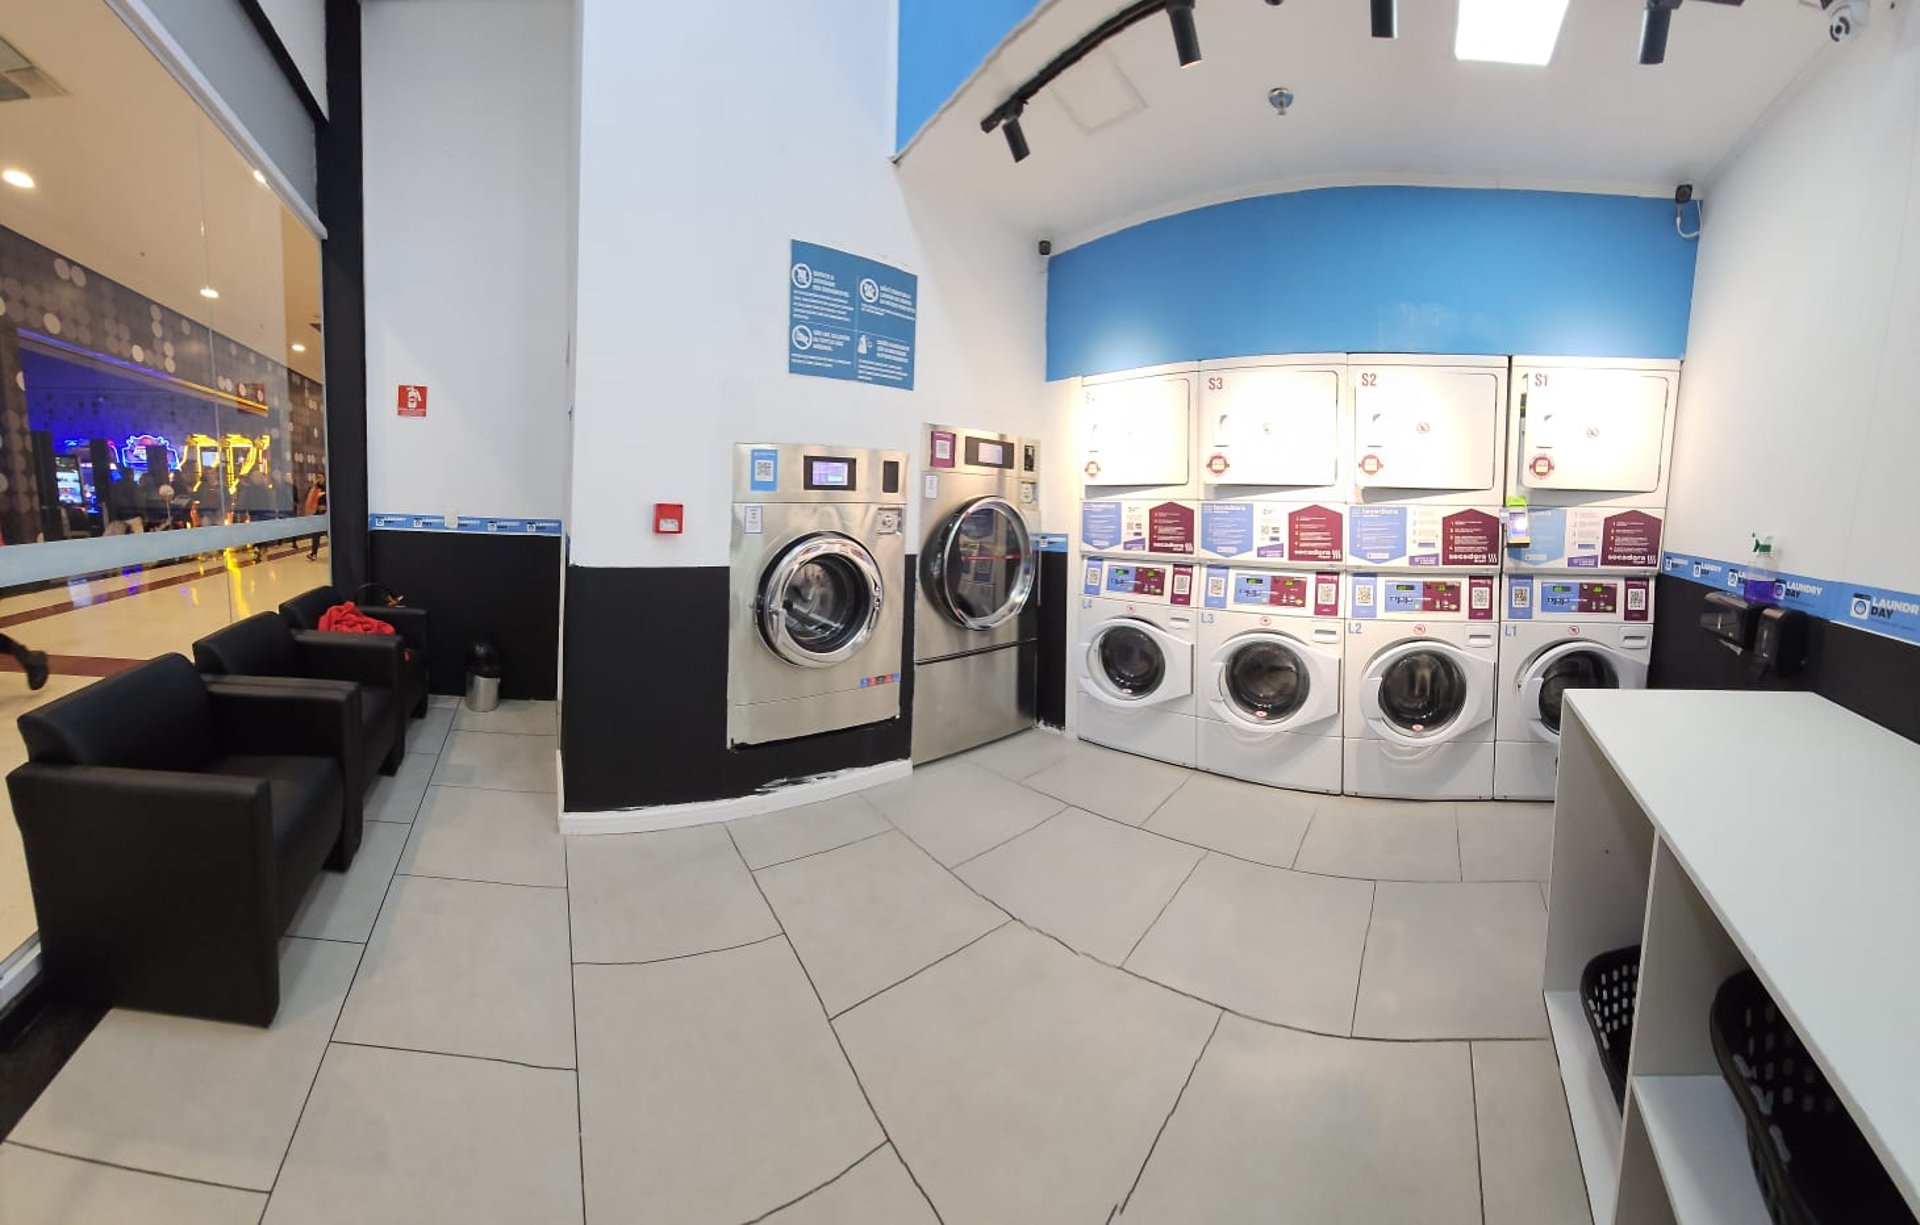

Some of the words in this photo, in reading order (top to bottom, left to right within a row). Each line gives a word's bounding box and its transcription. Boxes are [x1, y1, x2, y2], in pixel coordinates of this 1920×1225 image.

[1208, 377, 1223, 390] S3
[1361, 373, 1377, 387] S2
[1534, 373, 1548, 387] S1
[1448, 552, 1487, 561] secadora
[1607, 554, 1646, 562] secadora
[1785, 588, 1801, 599] DAY
[1786, 581, 1823, 596] LAUNDRY
[1870, 605, 1895, 619] DAY
[1872, 597, 1920, 616] LAUNDR
[1201, 612, 1215, 624] L3
[1348, 622, 1363, 635] L2
[1504, 625, 1517, 637] L1
